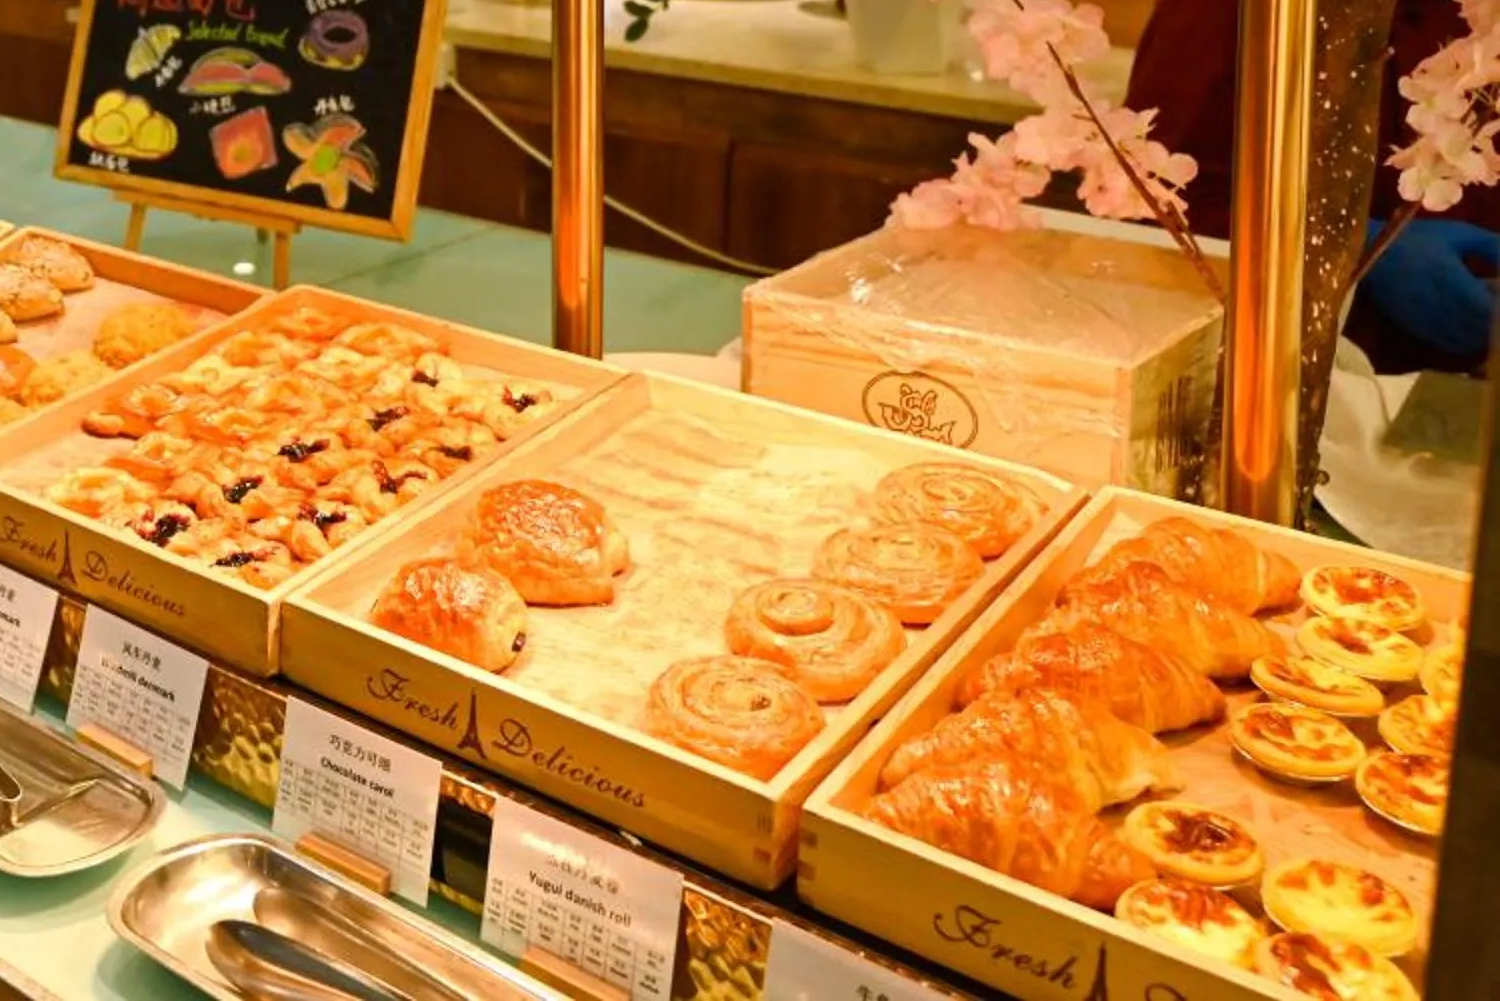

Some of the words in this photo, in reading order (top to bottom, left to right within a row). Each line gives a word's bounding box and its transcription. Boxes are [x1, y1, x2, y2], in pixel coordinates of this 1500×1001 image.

[185, 19, 243, 41] Selected
[82, 550, 186, 617] Delicious
[367, 668, 458, 731] Fresh
[491, 718, 646, 809] Delicious
[320, 756, 367, 787] Chocolate
[528, 869, 563, 896] Yugui
[564, 887, 607, 917] danish
[608, 911, 633, 929] roll
[932, 903, 1079, 990] Fresh
